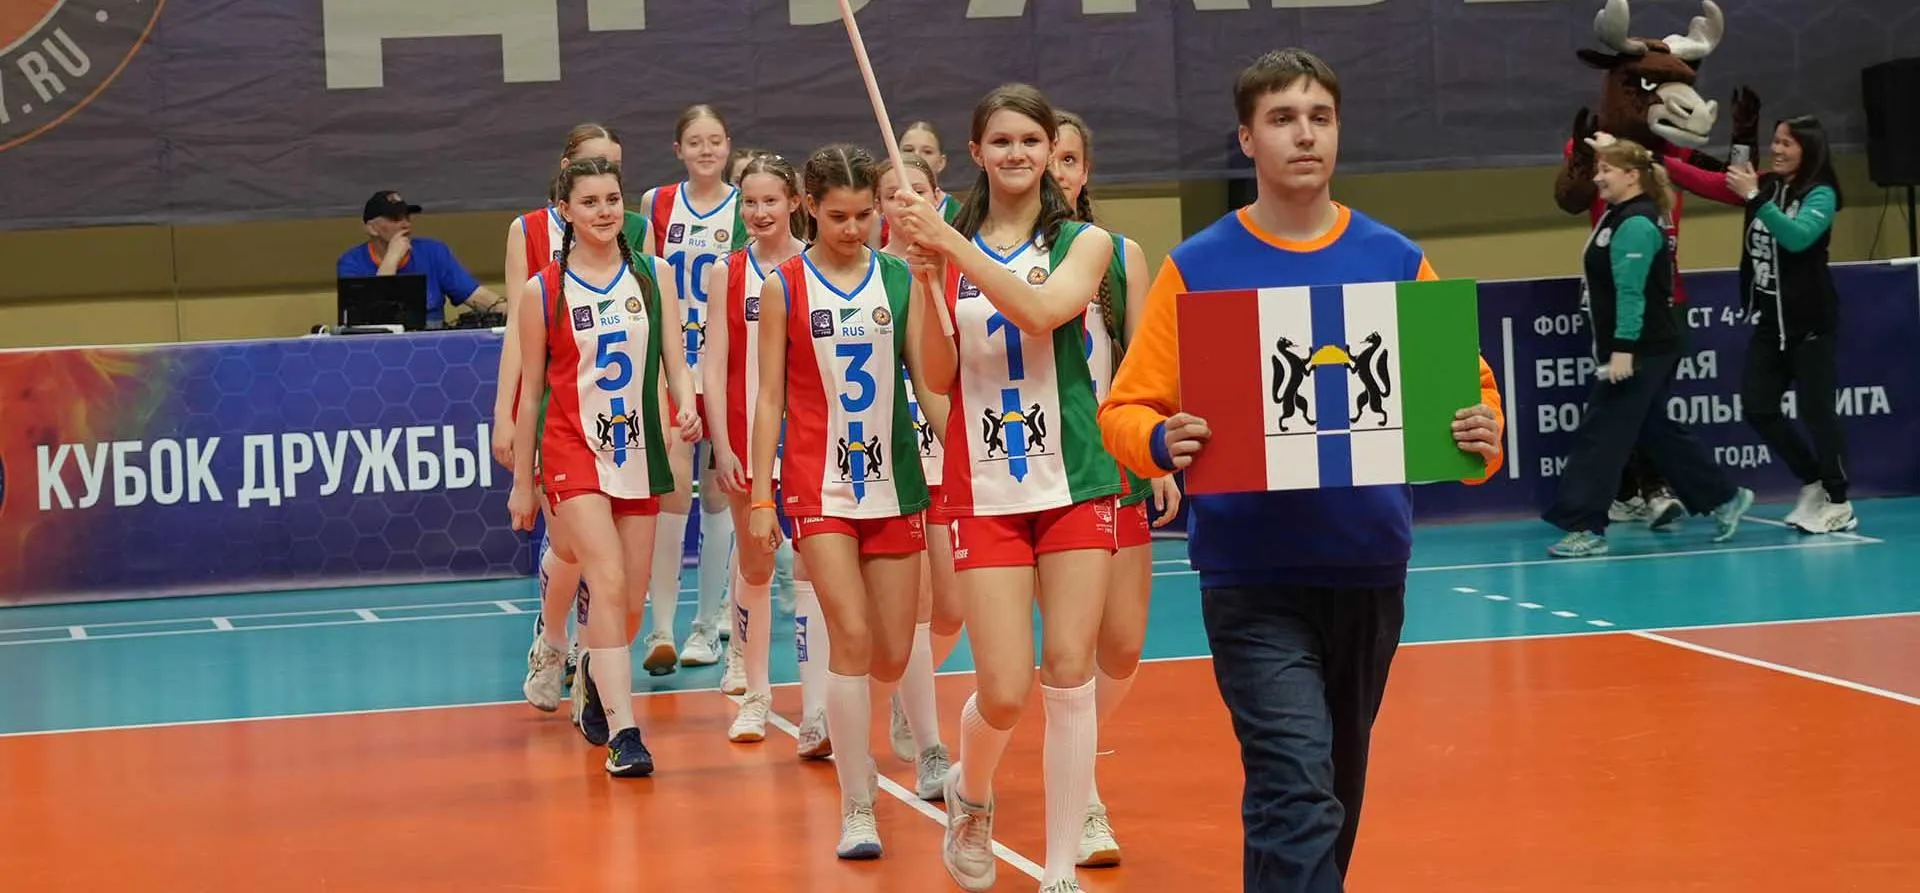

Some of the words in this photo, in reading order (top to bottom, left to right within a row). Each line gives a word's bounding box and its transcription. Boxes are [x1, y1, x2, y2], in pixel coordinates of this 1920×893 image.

[688, 238, 707, 247] RUS
[600, 315, 621, 326] RUS
[842, 326, 865, 337] RUS
[594, 330, 633, 391] 5
[986, 312, 1025, 381] 1
[835, 343, 876, 413] 3
[1835, 385, 1891, 416] ИГА
[36, 434, 223, 511] КУБОК
[237, 423, 493, 508] ДРУЖБЫ
[1714, 444, 1772, 468] ГОДА
